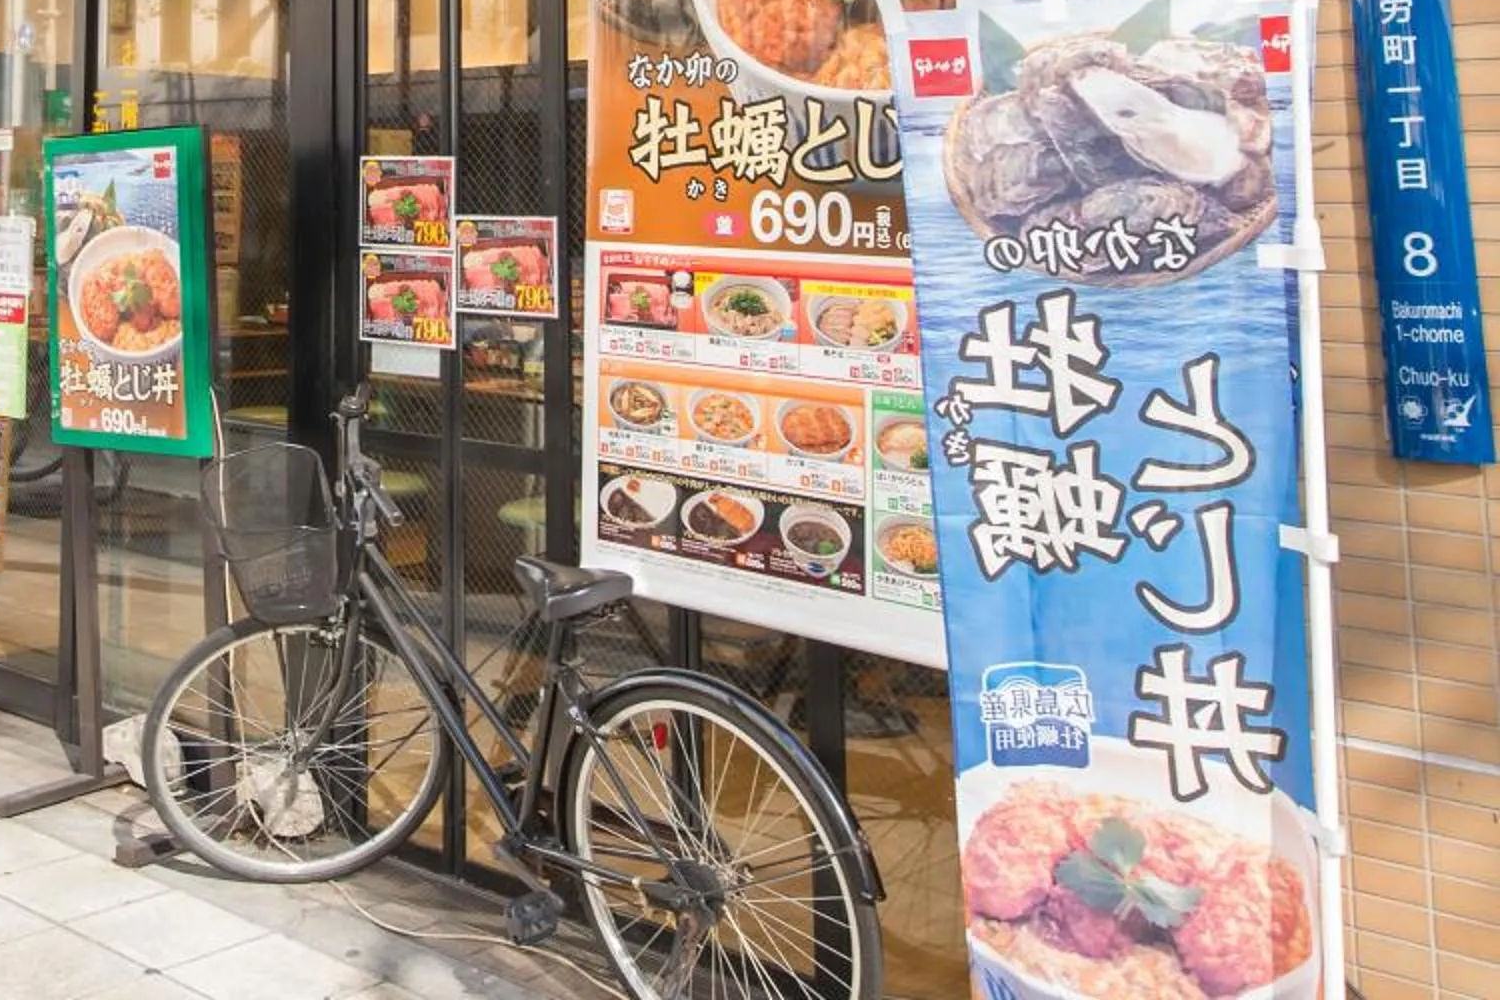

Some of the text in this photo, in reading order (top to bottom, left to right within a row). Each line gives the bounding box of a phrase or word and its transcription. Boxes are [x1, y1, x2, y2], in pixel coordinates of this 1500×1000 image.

[627, 54, 739, 89] なか卯の
[1402, 230, 1438, 277] 8
[1391, 300, 1463, 320] Bakuromachi
[1395, 324, 1465, 344] 1-chome
[60, 359, 179, 405] 牡蠣とじ丼
[1398, 366, 1470, 388] Chuo-ku
